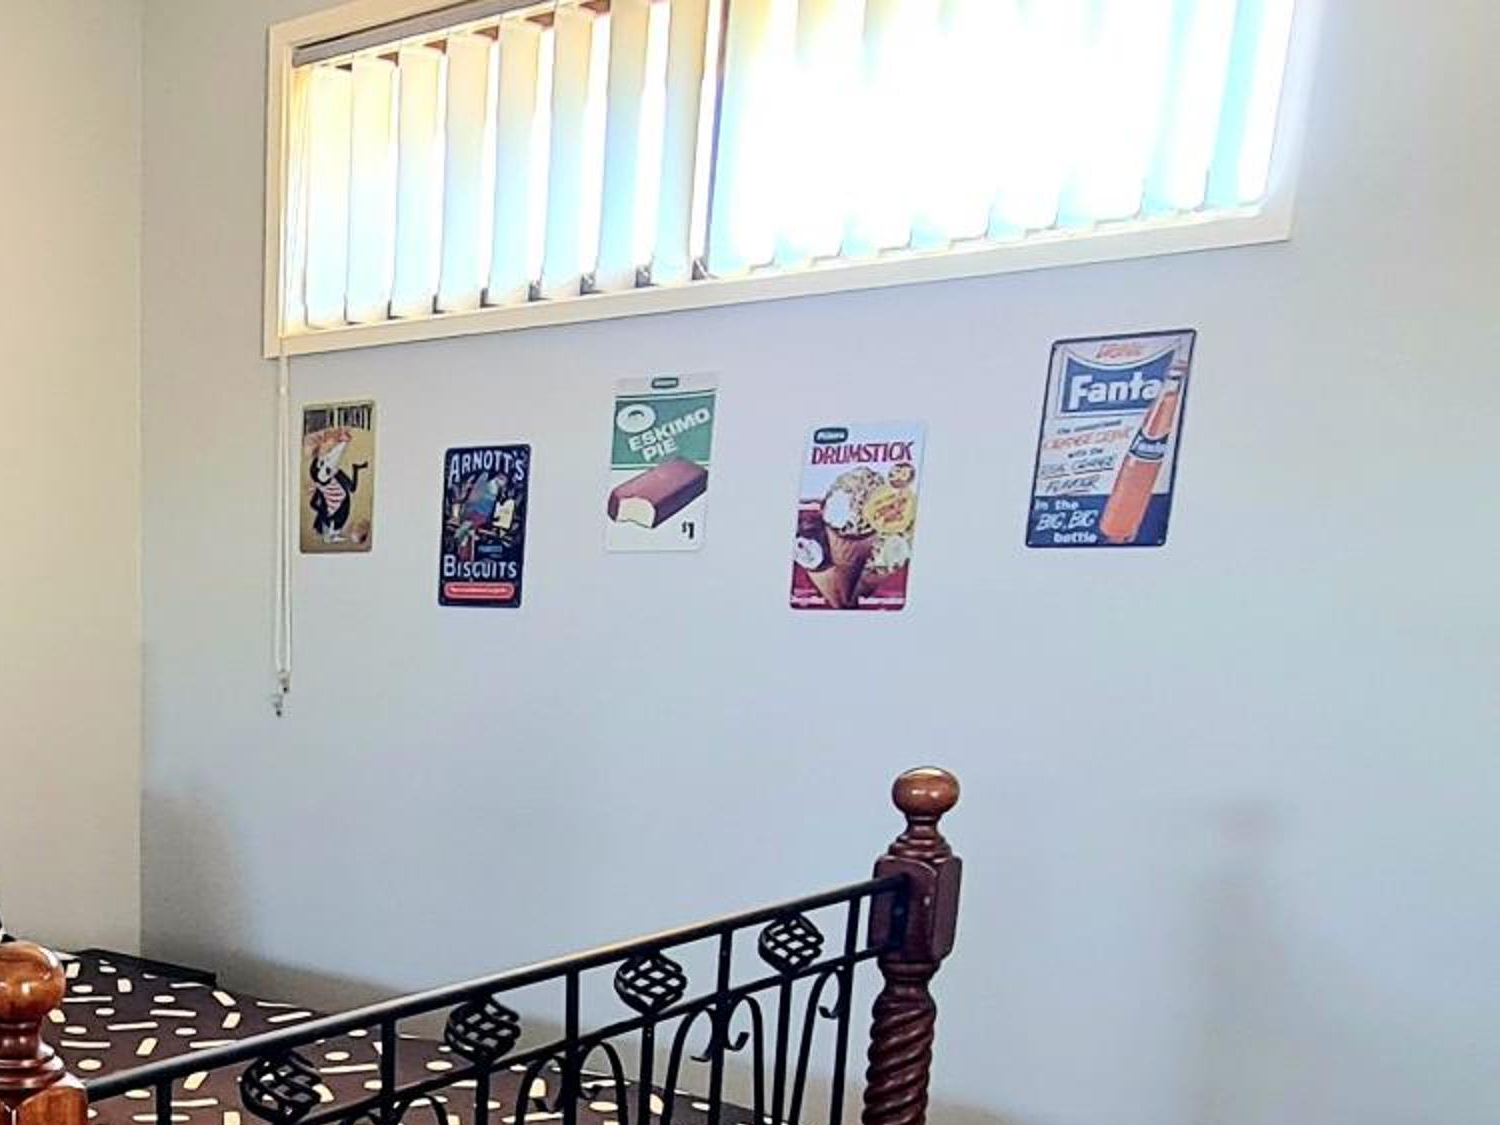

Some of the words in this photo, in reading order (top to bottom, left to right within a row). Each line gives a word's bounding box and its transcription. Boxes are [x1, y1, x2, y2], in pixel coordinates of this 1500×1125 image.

[1068, 371, 1163, 410] Fanta
[628, 407, 711, 451] ESKIMO
[641, 438, 678, 462] PIE
[812, 441, 914, 464] DRUMSTICK
[449, 450, 525, 488] ARNOTT'S
[682, 521, 694, 540] $1
[1054, 531, 1098, 544] bottle
[444, 554, 517, 578] BISCUITS
